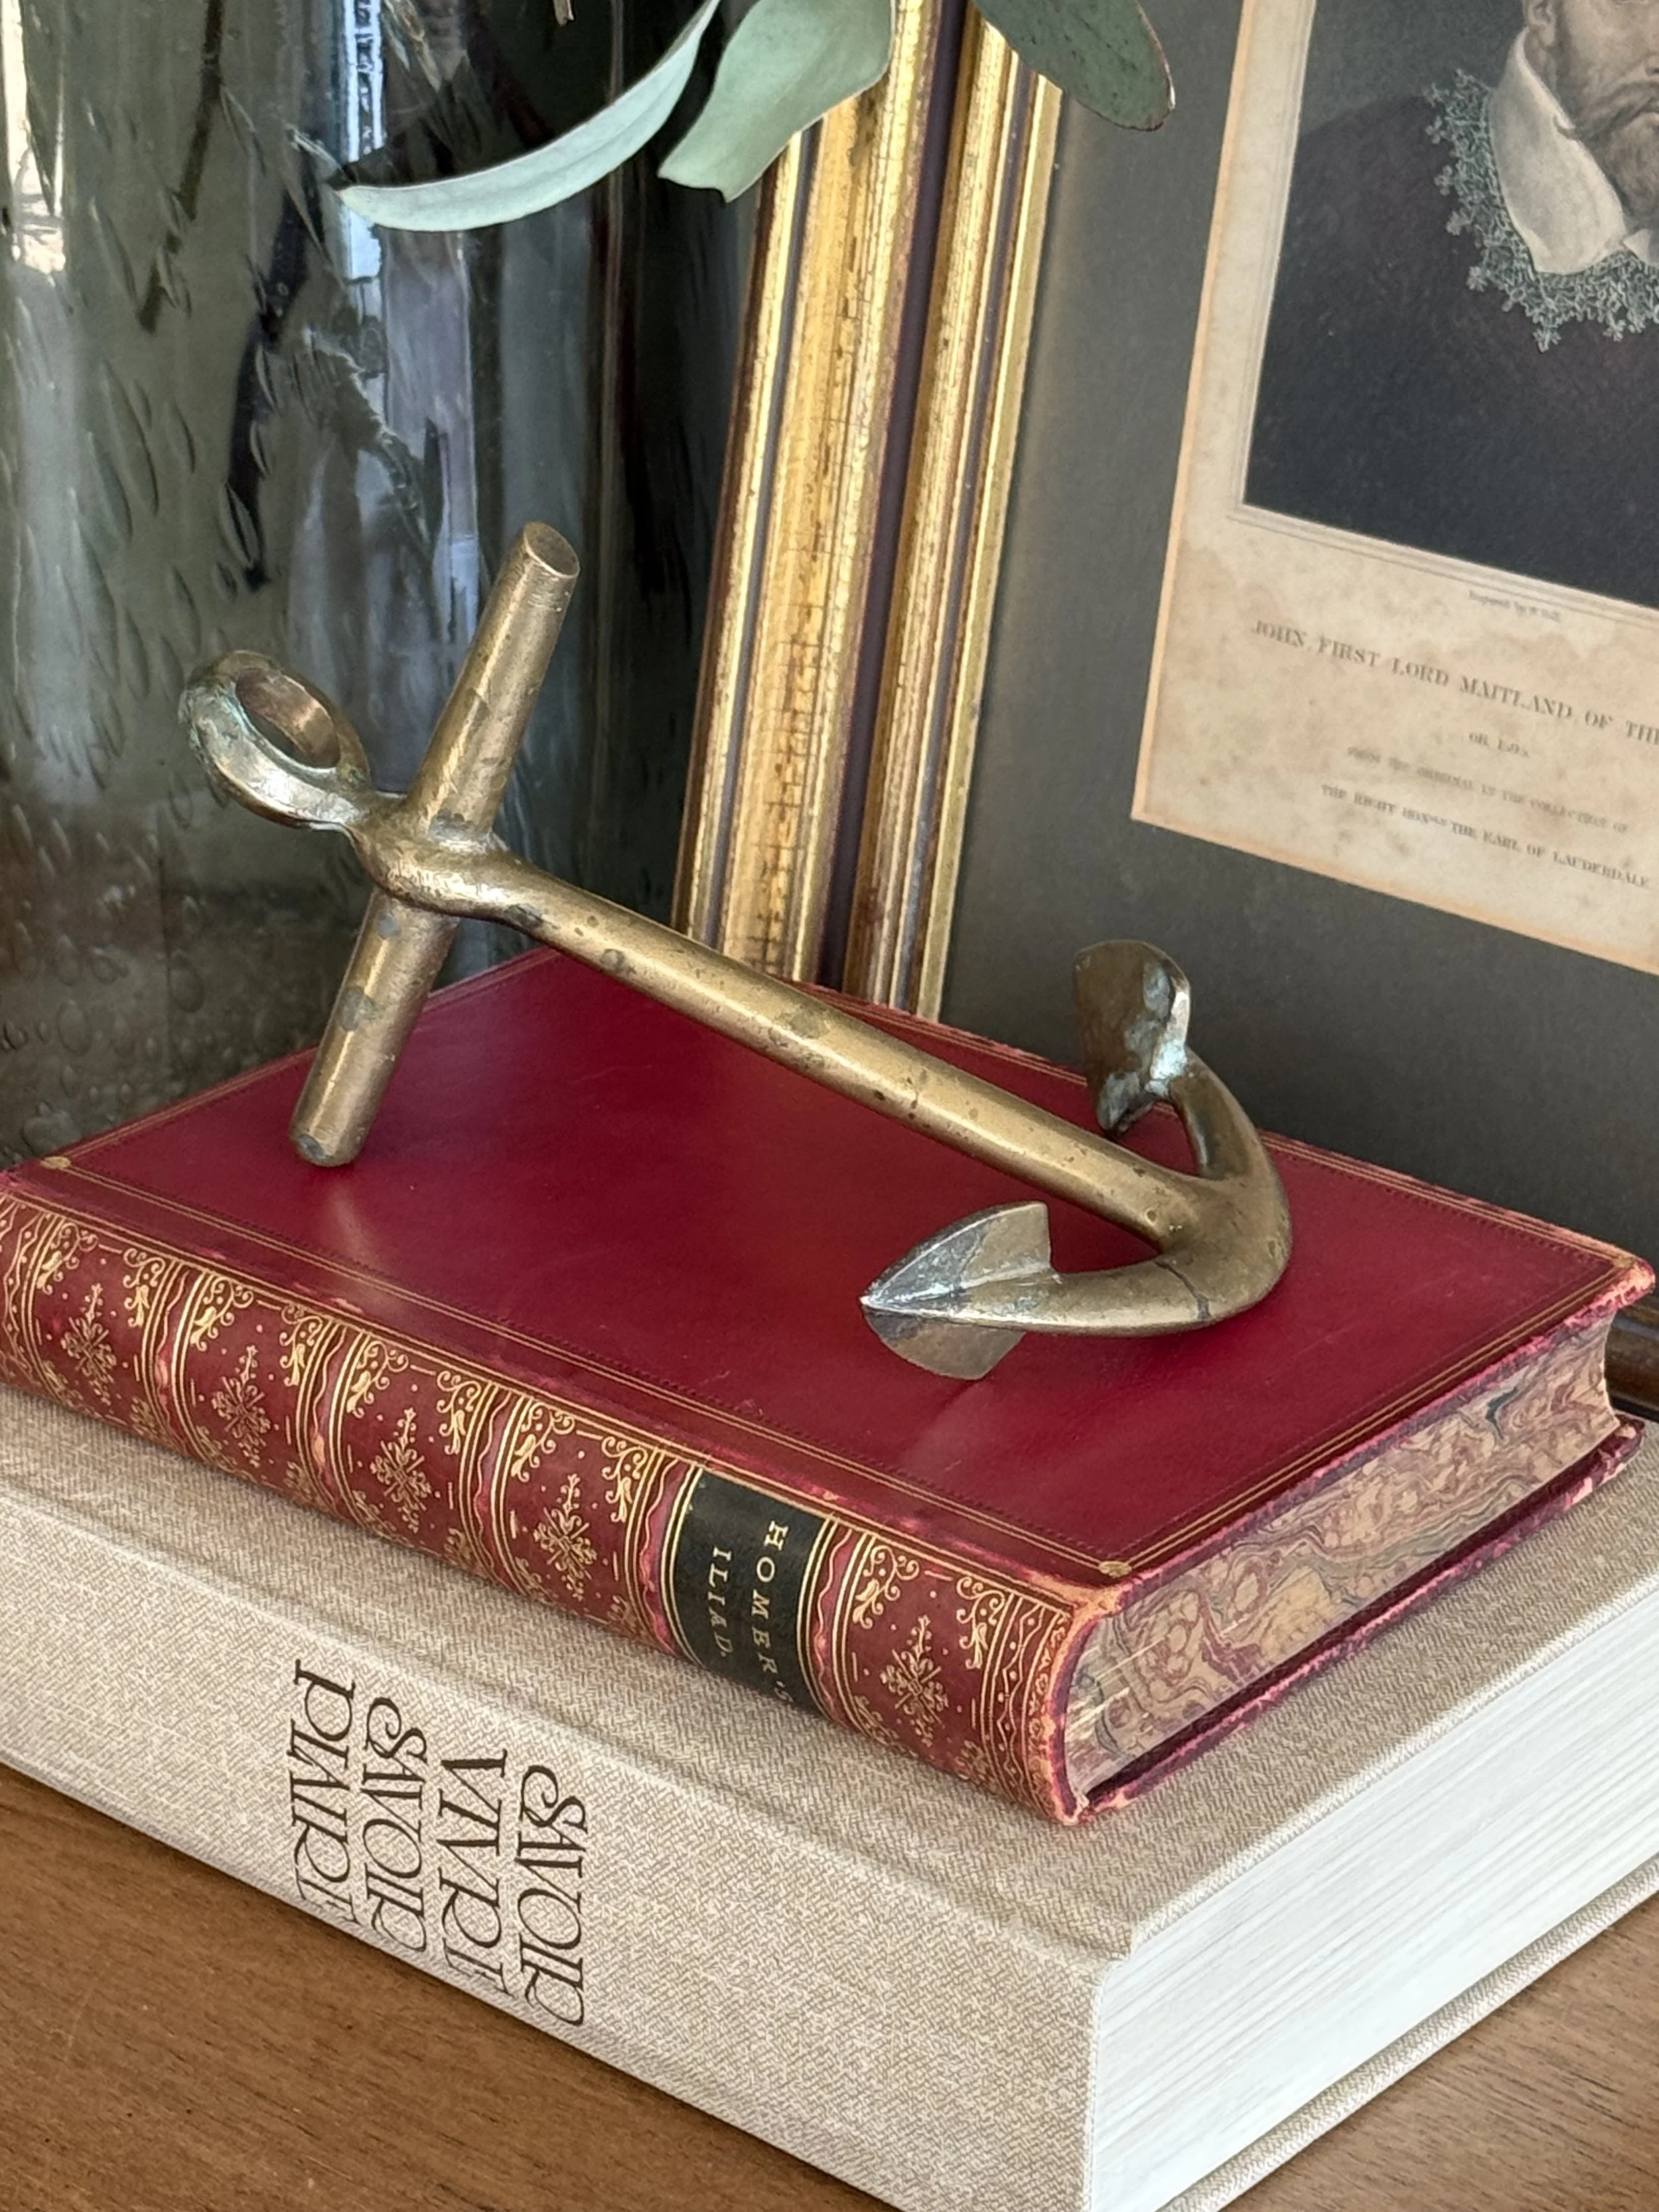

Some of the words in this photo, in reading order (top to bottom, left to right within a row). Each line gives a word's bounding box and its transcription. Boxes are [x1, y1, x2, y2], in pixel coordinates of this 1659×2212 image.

[1317, 633, 1380, 666] FIRST
[1392, 657, 1449, 686] LORD
[1459, 676, 1572, 719] MAITLAND
[1585, 710, 1614, 729] OF
[1450, 821, 1477, 838] THE
[1483, 831, 1521, 853] EARL
[1526, 844, 1546, 858] OF
[707, 1546, 733, 1657] ILIAD.
[751, 1520, 796, 1703] HOMER'S
[287, 1659, 360, 1925] PLAIRE
[359, 1696, 429, 1953] SAVOIR
[436, 1748, 514, 1998] VIVRE
[514, 1764, 588, 2027] SAVOIR
